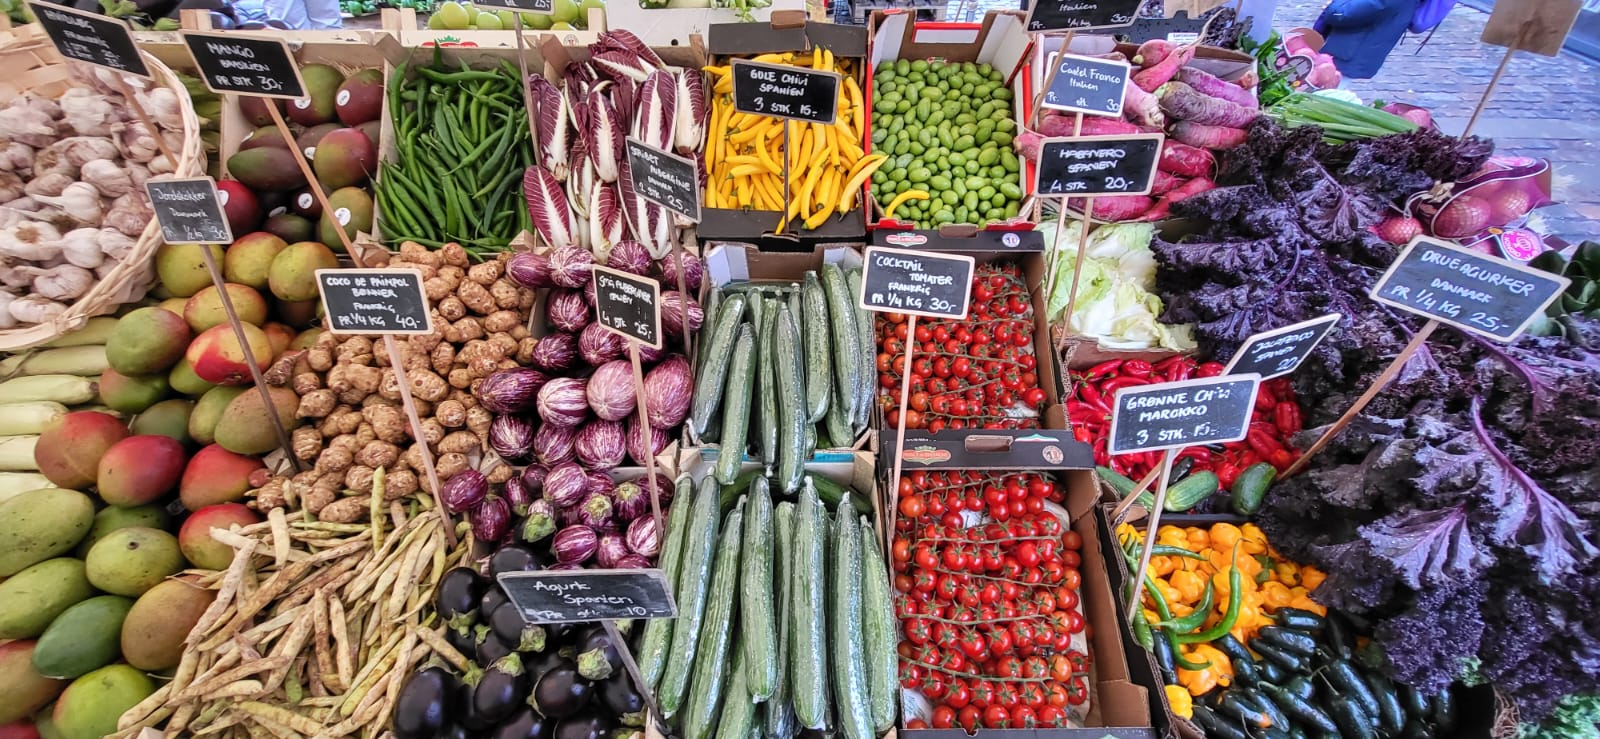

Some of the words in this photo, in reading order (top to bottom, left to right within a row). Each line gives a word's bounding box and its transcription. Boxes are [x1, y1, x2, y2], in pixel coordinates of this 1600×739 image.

[1059, 3, 1097, 12] Italien
[206, 42, 254, 59] MANGO
[219, 60, 271, 72] BRASILIEN
[215, 75, 231, 87] PR
[232, 76, 254, 87] STK
[750, 69, 777, 82] GULE
[781, 73, 809, 87] CHILI
[1089, 68, 1121, 84] Franco
[759, 83, 804, 97] SPANIEN
[1069, 78, 1099, 92] Italien
[753, 97, 764, 111] 3
[1060, 148, 1126, 159] HABANERO
[1067, 159, 1119, 173] SPANIEN
[1049, 179, 1062, 193] 4
[1065, 181, 1088, 191] STK
[1104, 177, 1134, 191] 20,-
[876, 256, 924, 272] COCKTAIL
[327, 277, 351, 286] COCO
[355, 278, 367, 287] DE
[370, 275, 409, 288] PAIMPOL
[909, 273, 953, 285] TOMATER
[888, 282, 931, 296] FRANKRIG
[1430, 277, 1493, 303] DANMARK
[872, 293, 884, 304] PR
[888, 293, 903, 308] 1/4
[906, 296, 922, 309] KG
[929, 297, 957, 313] 30,-
[1391, 285, 1411, 300] PR
[1415, 289, 1437, 309] 1/4
[1438, 301, 1461, 318] KG
[1469, 312, 1511, 332] 25,-
[338, 315, 354, 326] PR
[351, 313, 367, 325] 1/4
[369, 316, 386, 327] KG
[395, 314, 421, 329] 40,-
[602, 310, 611, 325] 4
[1126, 392, 1189, 411] GRØNNE
[1138, 405, 1208, 422] MAROKKO
[1136, 429, 1149, 445] 3
[533, 581, 591, 595] Agurk
[563, 594, 634, 607] Spanien
